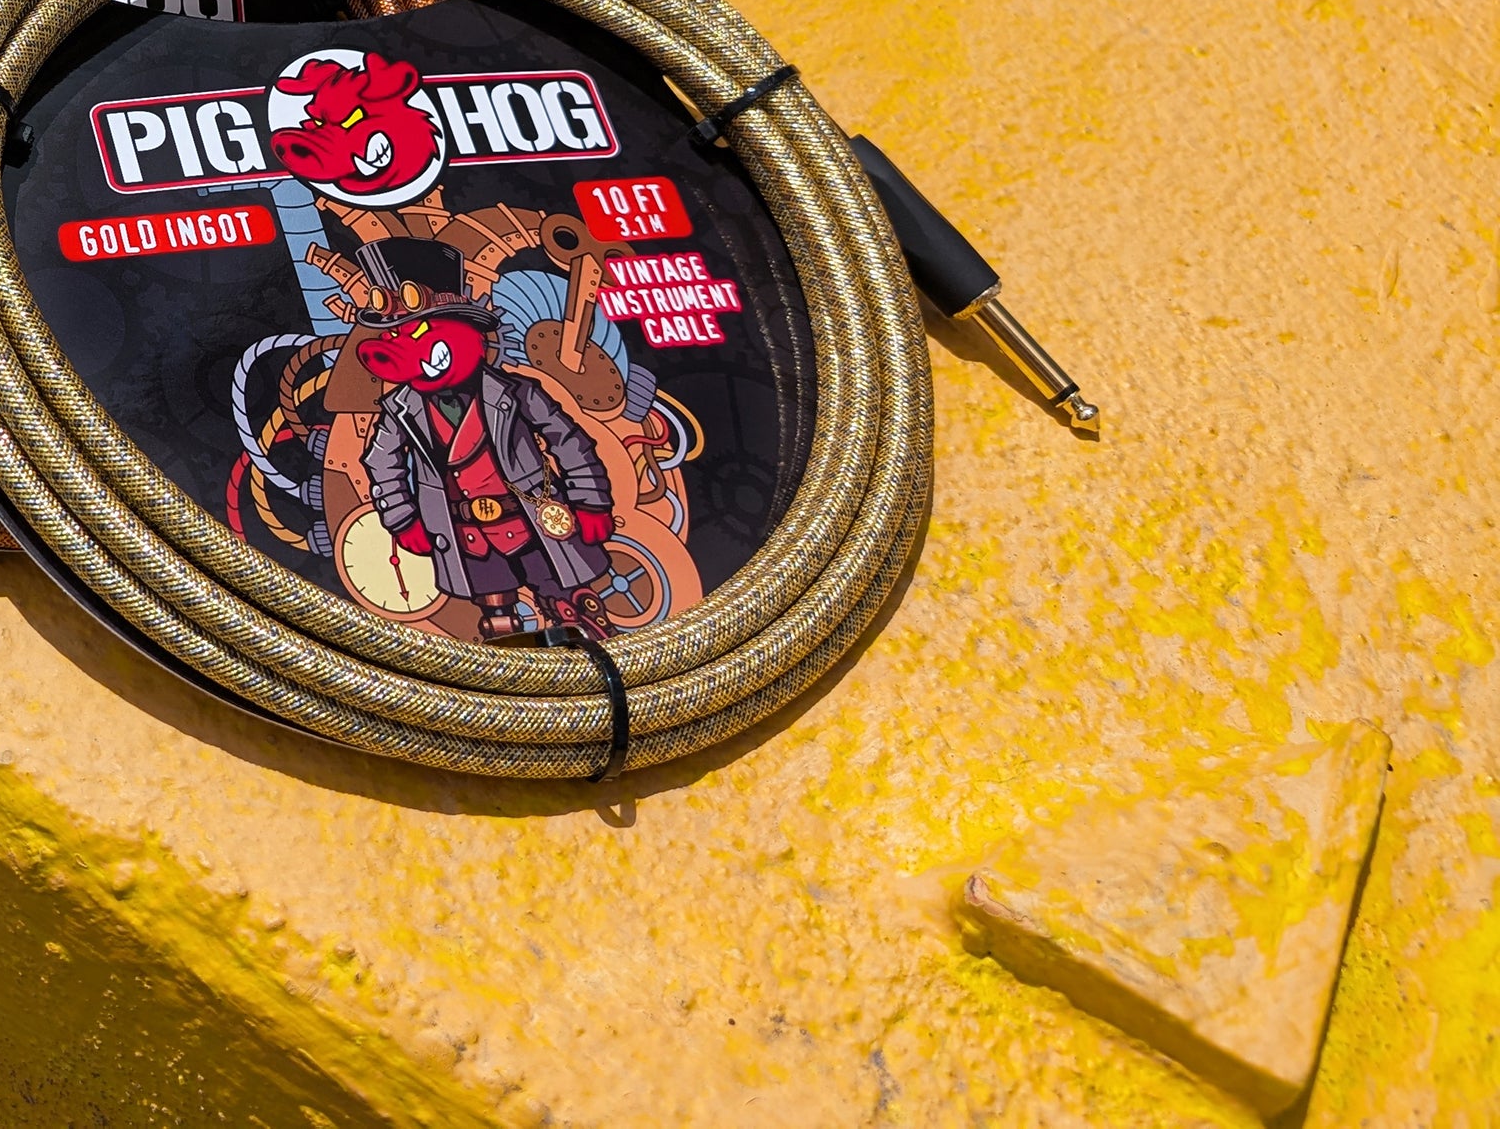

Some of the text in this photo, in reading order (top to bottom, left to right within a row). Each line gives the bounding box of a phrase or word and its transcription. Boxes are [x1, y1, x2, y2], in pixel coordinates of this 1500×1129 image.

[106, 81, 608, 183] PIG HOG
[592, 184, 668, 215] 10 FT
[78, 211, 253, 257] GOLD INGOT
[615, 216, 649, 237] 3.1
[609, 256, 708, 286] VINTAGE
[600, 283, 738, 317] INSTRUMENT
[644, 314, 721, 344] CABLE
